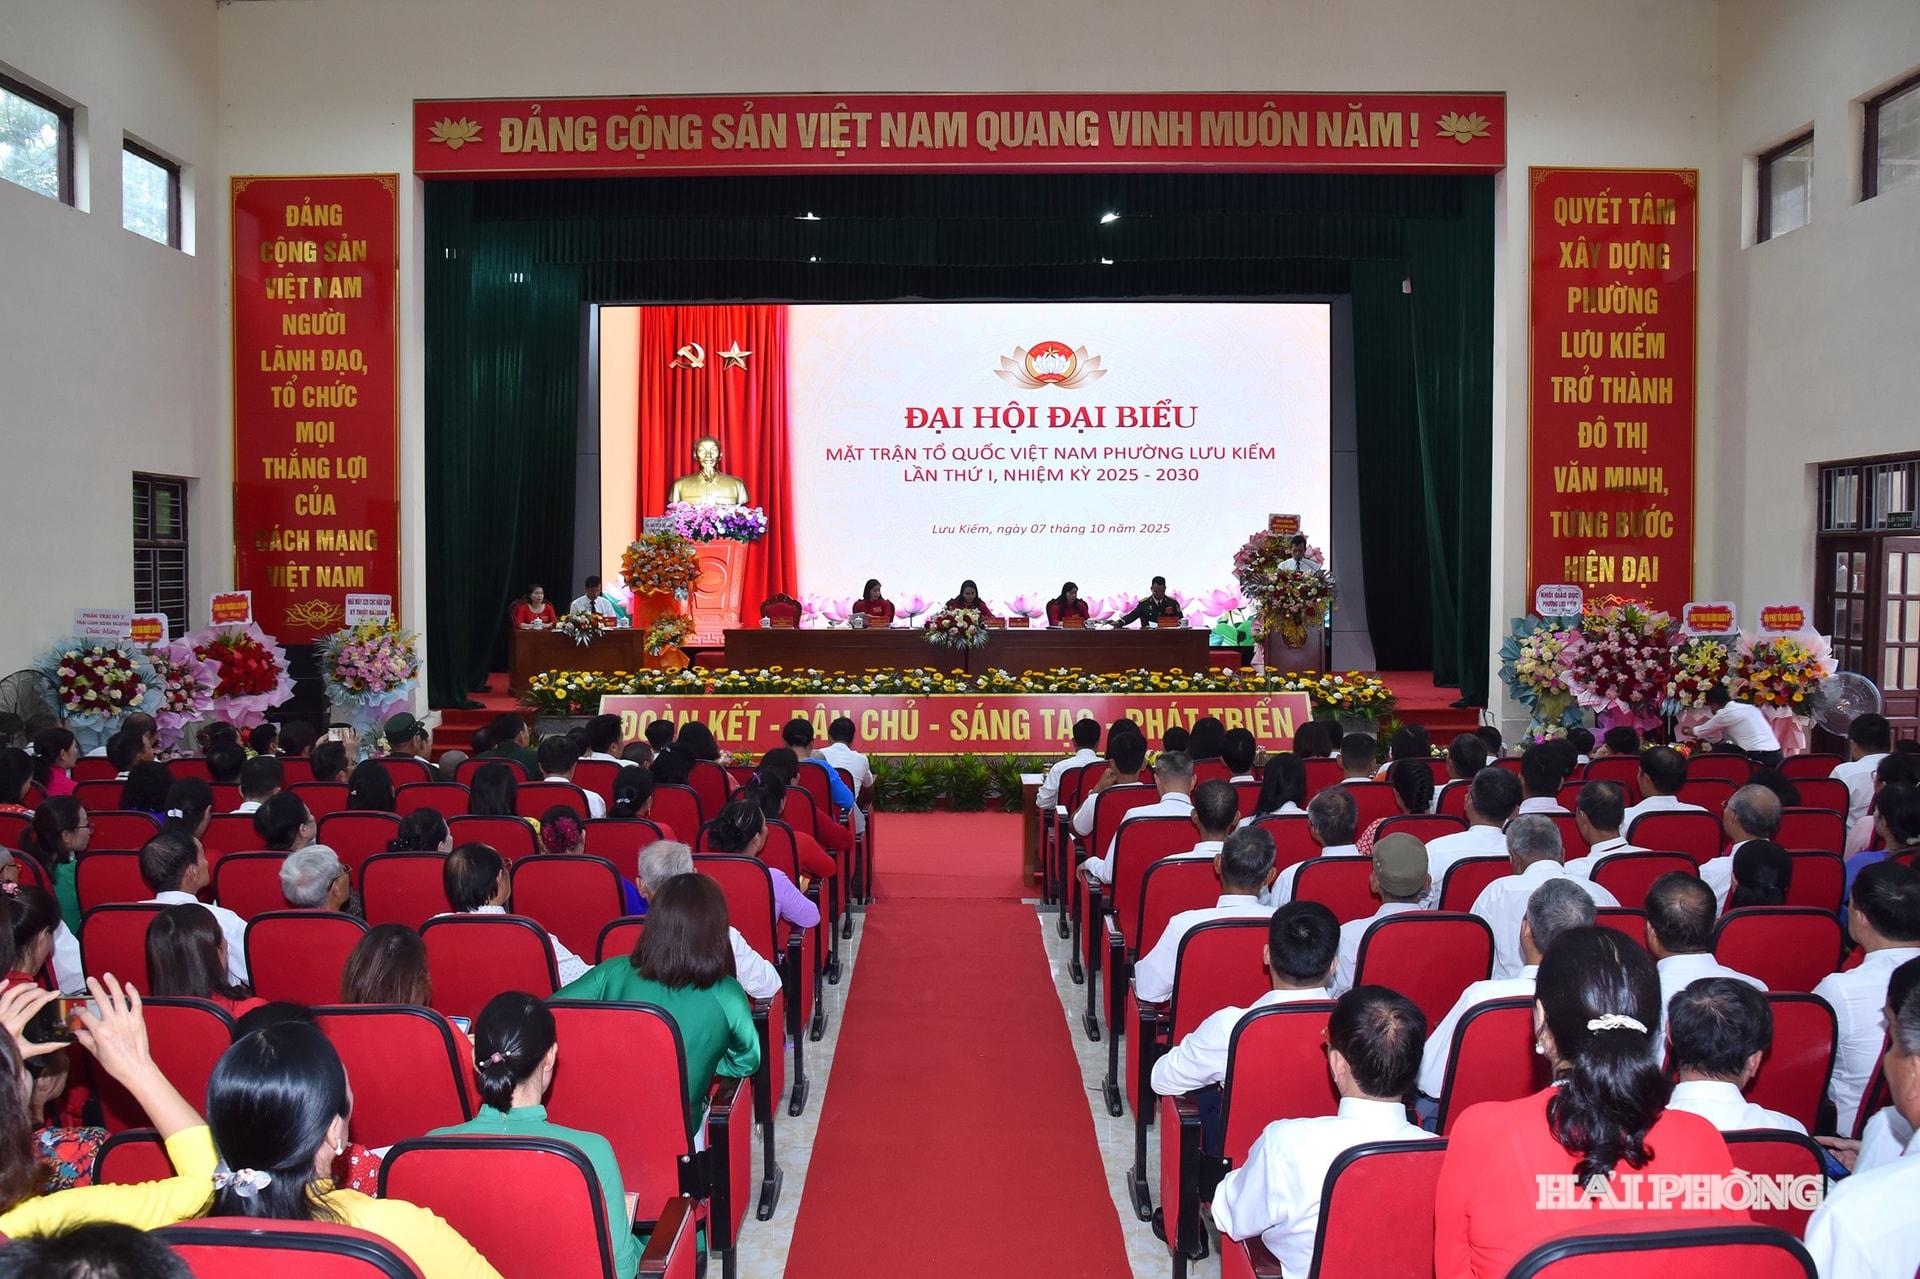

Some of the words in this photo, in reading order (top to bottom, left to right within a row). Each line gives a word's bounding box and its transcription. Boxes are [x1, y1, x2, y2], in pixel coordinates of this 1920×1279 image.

[499, 103, 597, 153] ĐẢNG
[605, 104, 703, 160] CỘNG
[711, 101, 787, 151] SẢN
[796, 102, 873, 157] VIỆT
[880, 110, 968, 149] NAM
[976, 110, 1099, 152] QUANG
[1107, 110, 1193, 148] VINH
[1200, 100, 1308, 149] MUÔN
[286, 196, 343, 227] ĐẢNG
[1553, 187, 1623, 227] QUYẾT
[1628, 191, 1677, 225] TÂM
[260, 235, 317, 268] CỘNG
[324, 233, 367, 263] SẢN
[1559, 235, 1601, 269] XÂY
[1609, 239, 1671, 275] DỰNG
[265, 272, 309, 304] VIỆT
[313, 276, 362, 299] NAM
[282, 307, 346, 336] NGƯỜI
[1561, 328, 1603, 359] LƯU
[1610, 322, 1665, 359] KIẾM
[261, 344, 315, 372] LÃNH
[321, 349, 368, 376] ĐẠO,
[271, 374, 296, 408] TỔ
[302, 379, 358, 408] CHỨC
[1550, 365, 1595, 404] TRỞ
[1600, 370, 1673, 404] THÀNH
[904, 406, 965, 434] ĐẠI
[972, 400, 1040, 434] HỘI
[1047, 406, 1107, 434] ĐẠI
[1115, 398, 1199, 429] BIỂU
[295, 421, 335, 448] MỌI
[1577, 415, 1608, 449] ĐÔ
[1613, 422, 1648, 454] THỊ
[262, 448, 330, 480] THẮNG
[336, 455, 368, 484] LỢI
[825, 444, 865, 463] MẶT
[869, 444, 917, 463] TRẬN
[922, 442, 947, 461] TỔ
[951, 442, 1006, 462] QUỐC
[1010, 444, 1048, 463] VIỆT
[1054, 446, 1097, 460] NAM
[1103, 443, 1184, 460] PHƯỜNG
[1189, 446, 1226, 460] LƯU
[1232, 442, 1275, 460] KIẾM
[904, 464, 938, 482] LẦN
[943, 466, 983, 482] THỨ
[988, 469, 998, 484] I,
[1003, 466, 1064, 483] NHIỆM
[1070, 465, 1091, 481] KỲ
[1096, 468, 1139, 481] 2025
[1156, 468, 1199, 481] 2030
[1553, 460, 1598, 493] VĂN
[1604, 466, 1669, 497] MINH,
[295, 484, 337, 516] CỦA
[932, 524, 955, 534] Lưu
[958, 523, 993, 535] Kiếm,
[996, 524, 1028, 536] ngày
[1030, 524, 1047, 534] 07
[1049, 523, 1086, 536] tháng
[1090, 523, 1105, 534] 10
[1108, 523, 1136, 534] năm
[1139, 523, 1171, 534] 2025
[1550, 505, 1608, 539] TỪNG
[1615, 503, 1674, 539] BƯỚC
[316, 528, 378, 557] MẠNG
[267, 560, 310, 592] VIỆT
[316, 566, 364, 588] NAM
[1564, 549, 1614, 588] HIỆN
[1621, 555, 1659, 588] ĐẠI
[707, 701, 762, 741] KẾT
[860, 700, 920, 741] CHỦ
[950, 702, 1031, 741] SÁNG
[1125, 701, 1200, 740] PHÁT
